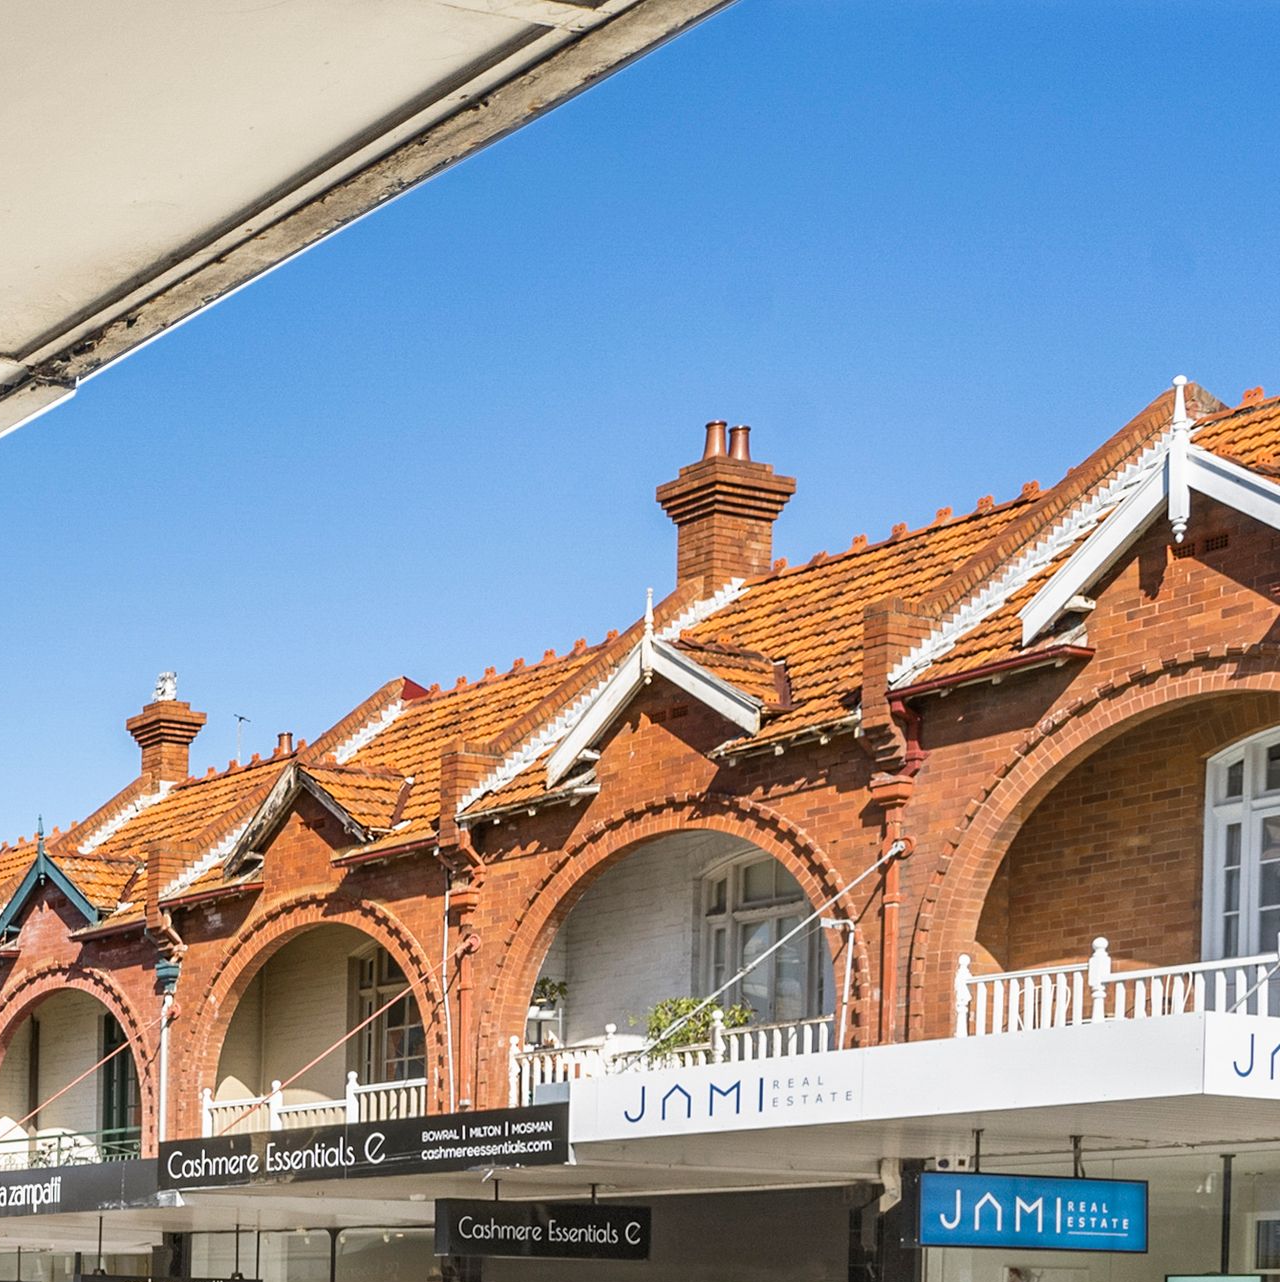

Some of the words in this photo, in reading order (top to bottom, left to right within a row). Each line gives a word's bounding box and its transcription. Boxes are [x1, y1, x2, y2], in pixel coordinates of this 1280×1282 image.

[624, 1077, 764, 1122] JAMI
[772, 1075, 824, 1090] REAL
[772, 1090, 853, 1108] ESTATE
[422, 1129, 460, 1143] BOWRAL
[469, 1125, 502, 1139] MILTON
[511, 1120, 552, 1135] MOSMAN
[167, 1151, 259, 1179] Cashmere
[266, 1137, 356, 1172] Essentials
[421, 1138, 552, 1161] cashmereessentials.com
[8, 1175, 61, 1213] zampatti
[940, 1189, 1062, 1234] JAMI
[1067, 1201, 1108, 1213] REAL
[1067, 1216, 1129, 1230] ESTATE
[458, 1216, 542, 1241] Cashmere
[548, 1219, 619, 1244] Essentials
